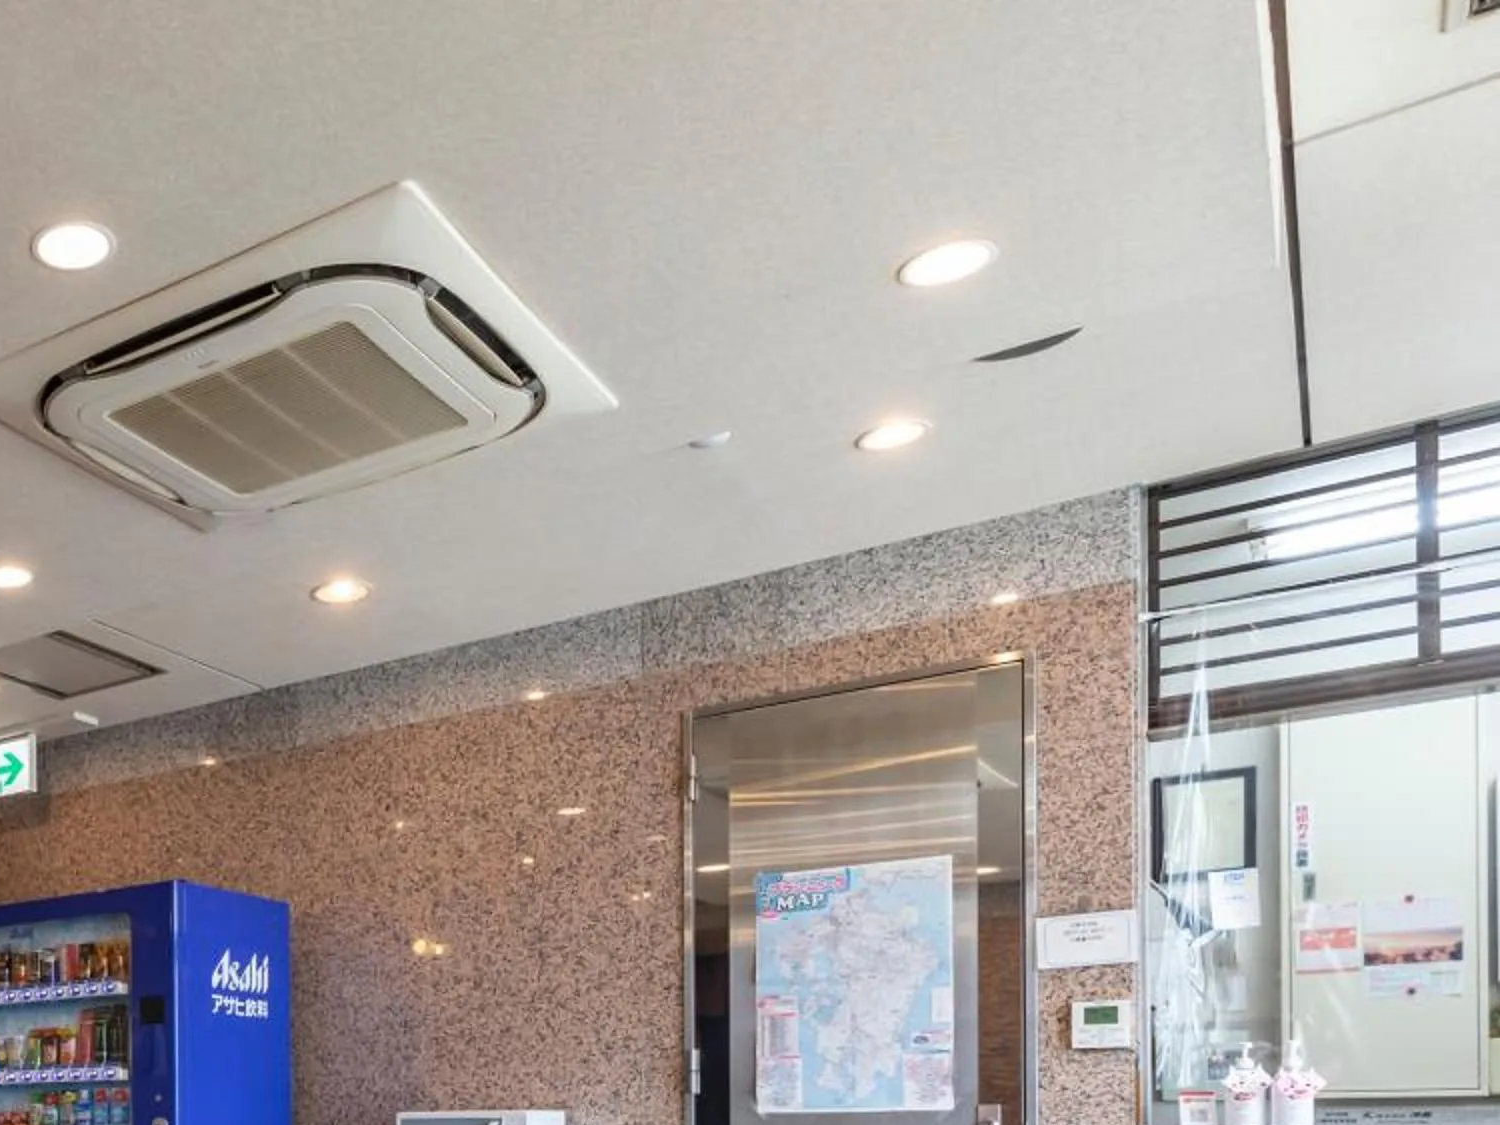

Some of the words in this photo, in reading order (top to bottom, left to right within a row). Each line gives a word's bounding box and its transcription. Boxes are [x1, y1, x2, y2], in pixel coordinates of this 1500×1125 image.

[777, 893, 824, 911] MAP
[211, 948, 269, 994] Asahi
[211, 994, 269, 1018] アサヒ飲料
